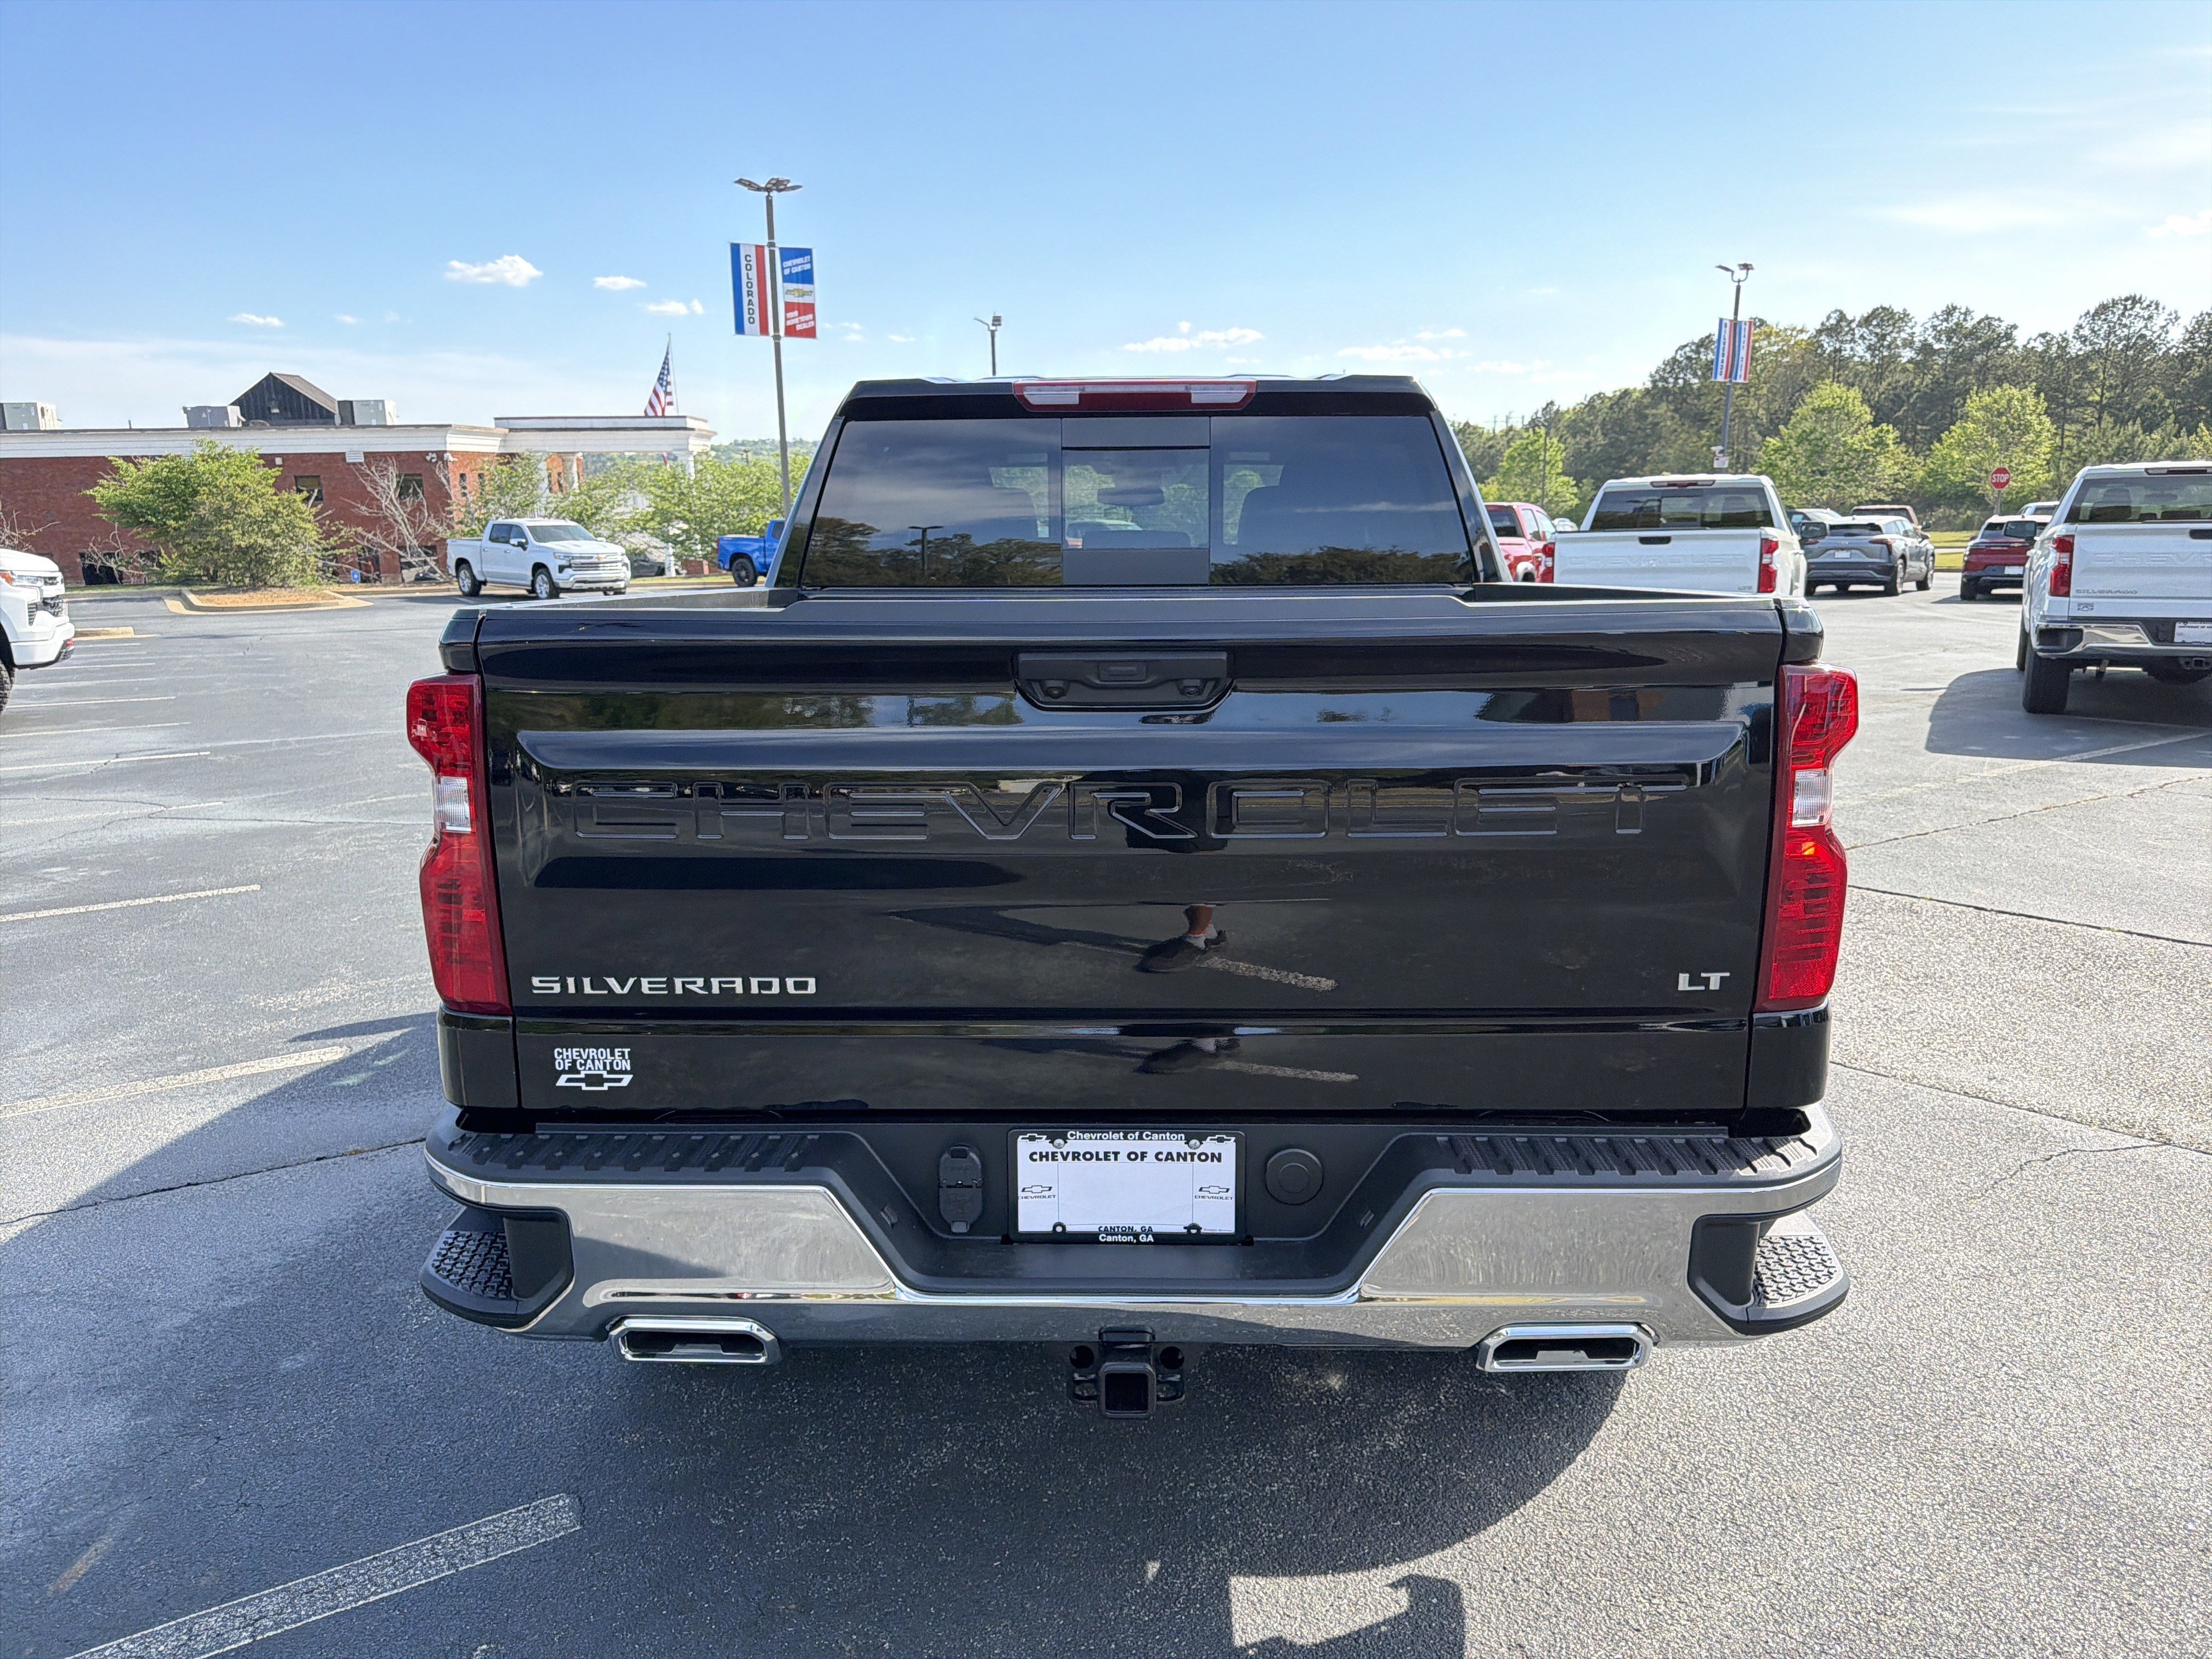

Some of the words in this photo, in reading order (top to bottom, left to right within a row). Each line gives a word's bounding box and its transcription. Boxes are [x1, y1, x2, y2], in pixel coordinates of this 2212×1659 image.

[744, 254, 755, 325] COLORADO
[1991, 473, 2009, 483] STOP
[572, 775, 1689, 840] CHEVROLET
[531, 976, 817, 994] SILVERADO
[1677, 972, 1730, 991] LT
[554, 1048, 631, 1060] CHEVROLET
[555, 1059, 572, 1070] OF
[576, 1059, 631, 1071] CANTON
[1067, 1131, 1124, 1140] Chevrolet
[1127, 1131, 1139, 1141] of
[1142, 1132, 1185, 1141] Canton
[1029, 1151, 1120, 1162] CHEVROLET
[1126, 1152, 1148, 1162] OF
[1154, 1152, 1222, 1163] CANTON
[1098, 1233, 1137, 1244] Canton,
[1139, 1234, 1155, 1243] GA
